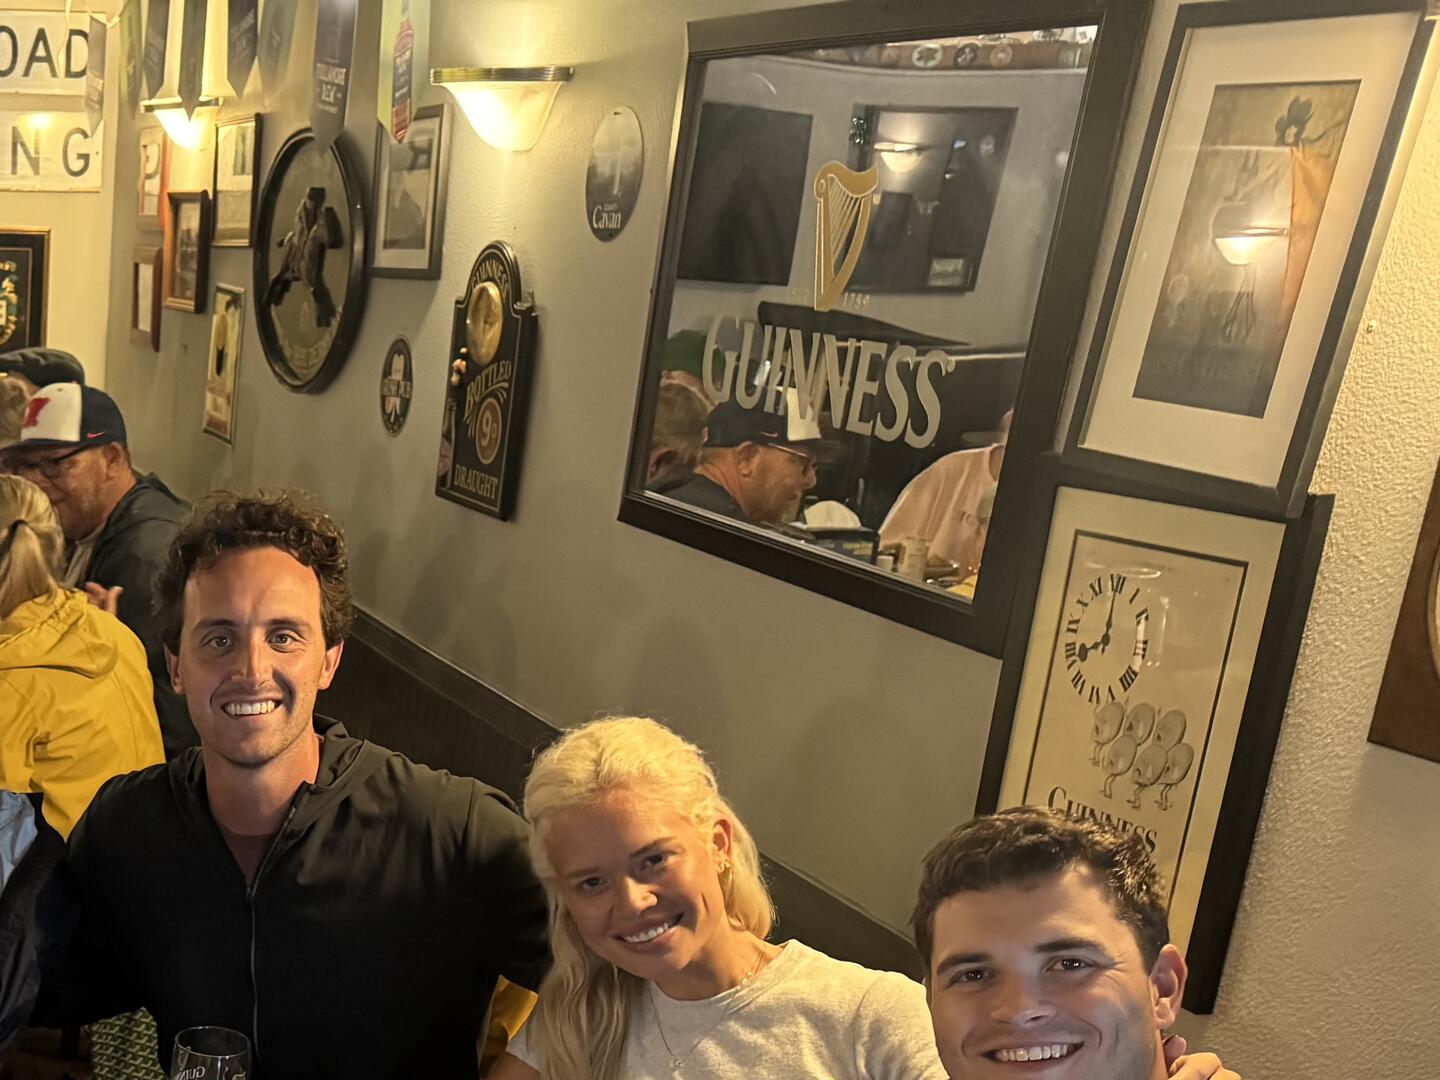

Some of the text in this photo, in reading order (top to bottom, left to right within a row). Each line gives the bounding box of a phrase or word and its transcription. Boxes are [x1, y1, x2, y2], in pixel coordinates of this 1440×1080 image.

[593, 204, 621, 229] Cavan
[465, 359, 511, 417] BOTTLED
[703, 314, 946, 449] GUINNESS
[454, 464, 498, 499] DRAUGHT
